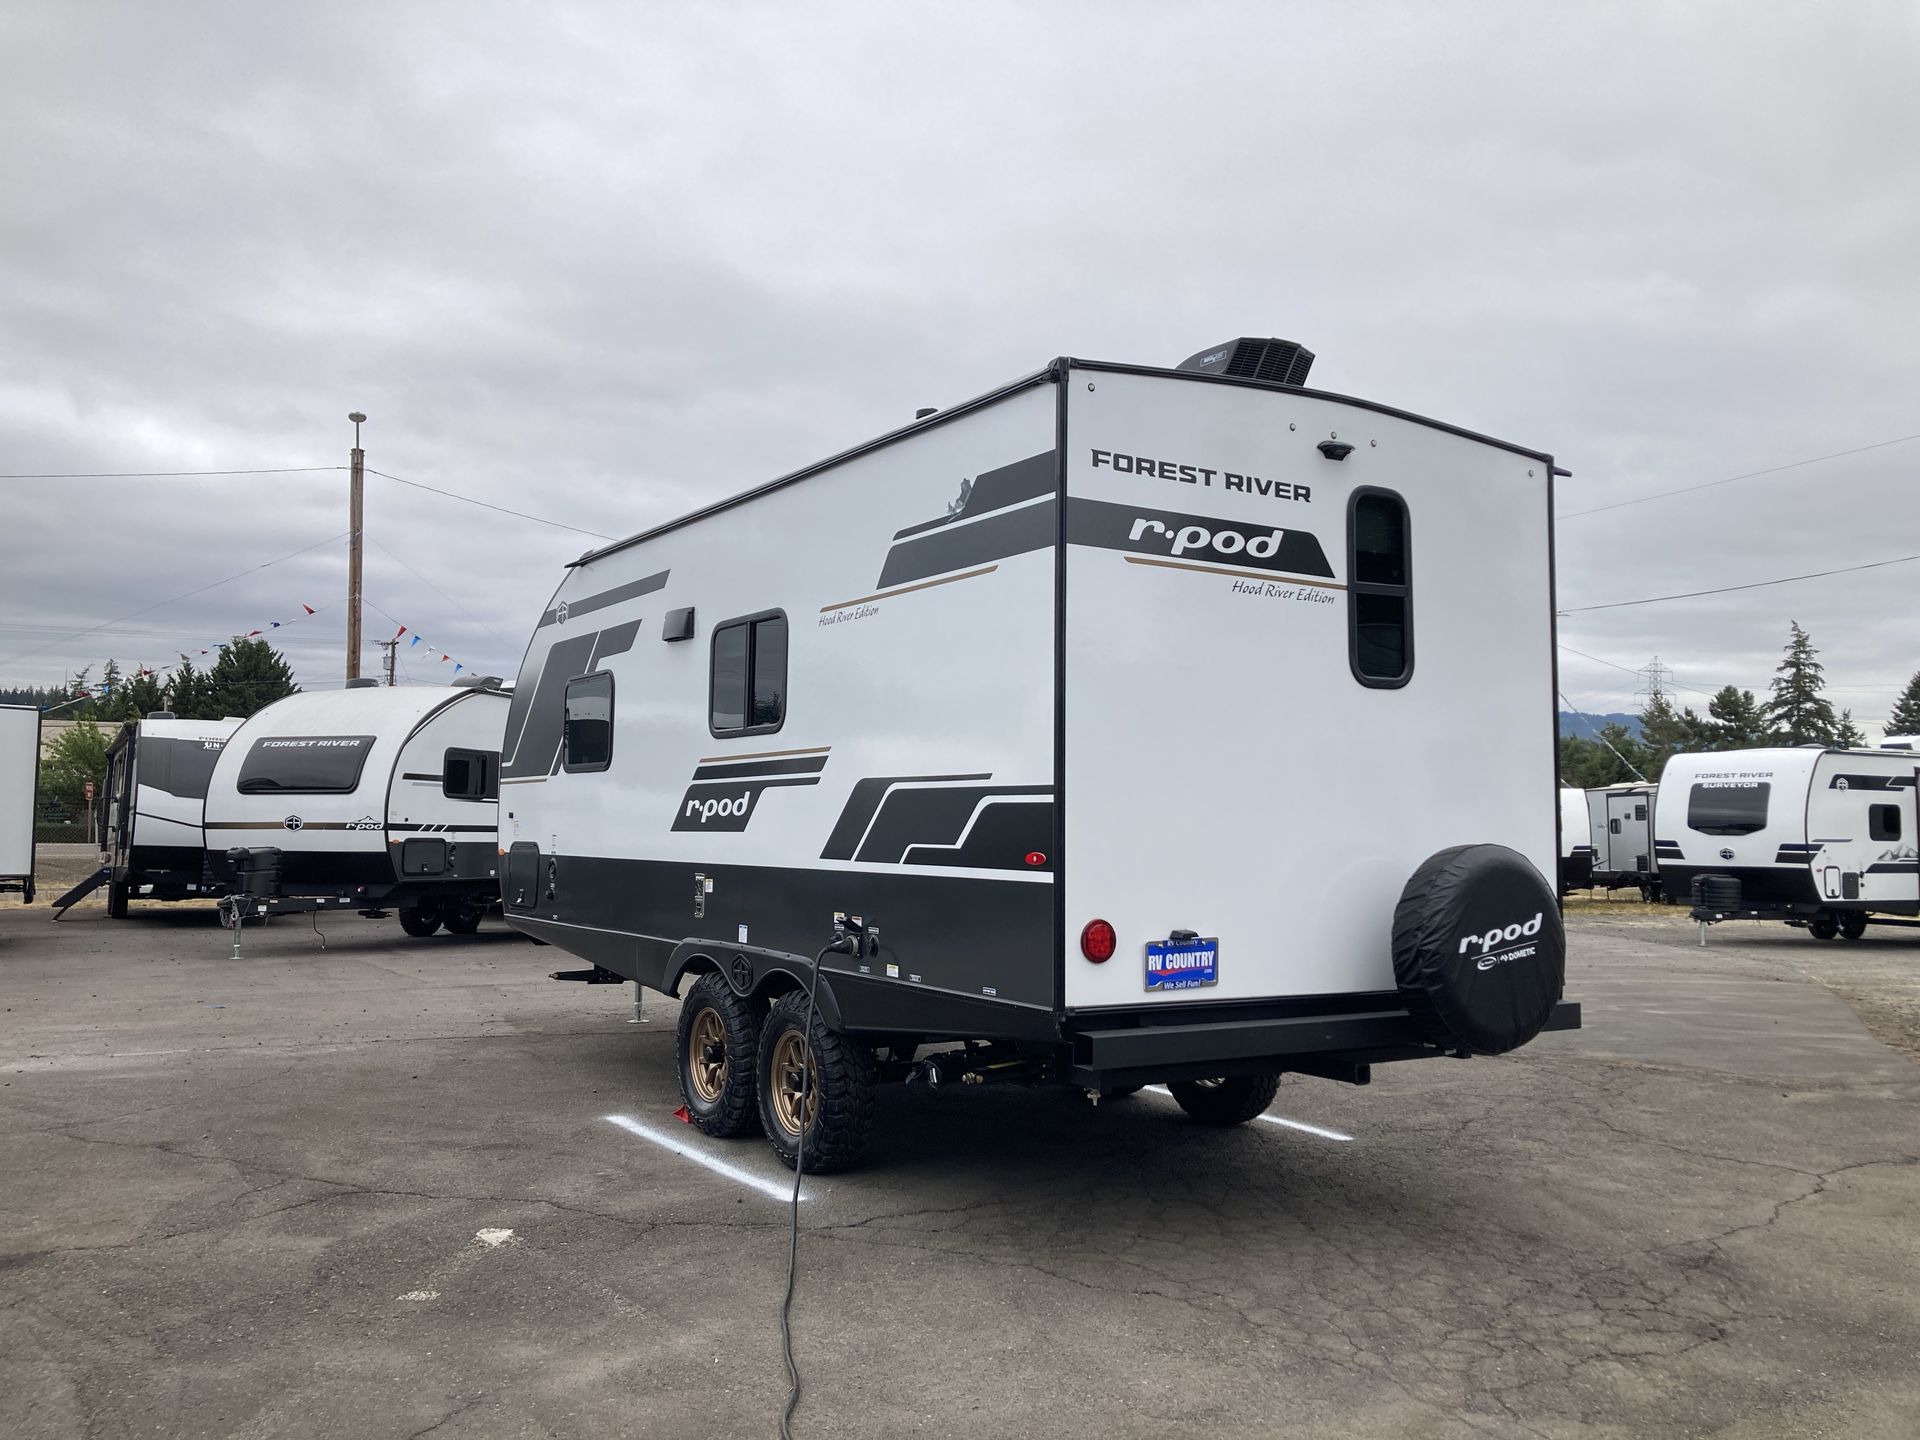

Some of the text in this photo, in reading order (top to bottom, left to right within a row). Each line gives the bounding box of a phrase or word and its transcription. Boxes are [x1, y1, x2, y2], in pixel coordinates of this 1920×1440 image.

[1091, 448, 1311, 503] FOREST RIVER
[1232, 580, 1335, 605] Hood River Edition
[819, 604, 879, 627] Hood River Edition
[262, 740, 317, 748] FOREST
[1148, 950, 1215, 971] RV COUNTRY
[1508, 946, 1536, 961] DOMETIC
[1164, 982, 1174, 990] We
[1187, 979, 1201, 987] Fun!
